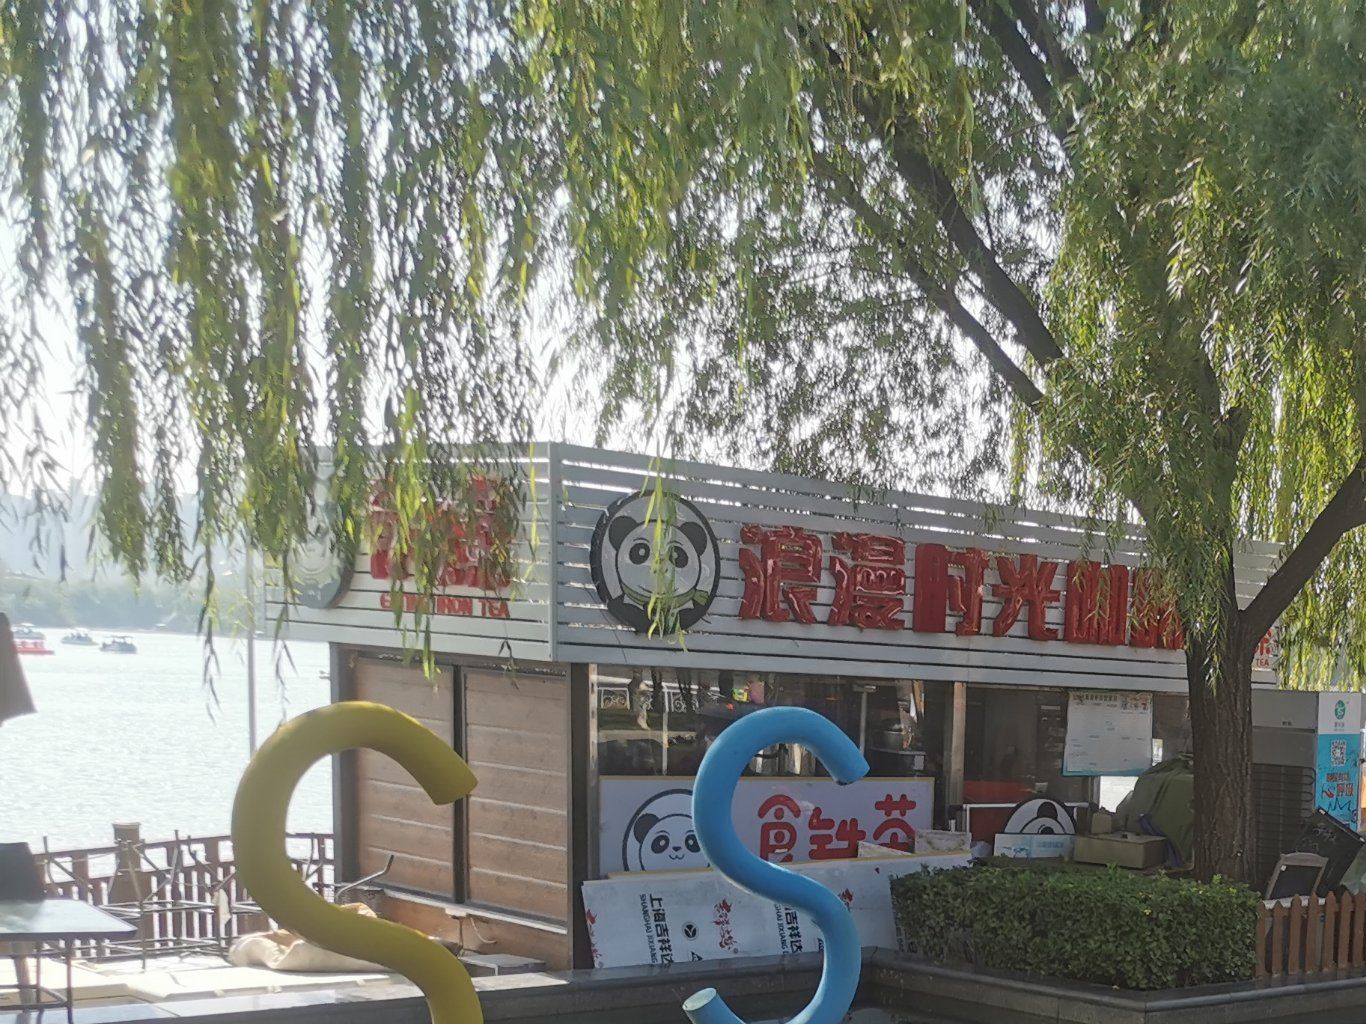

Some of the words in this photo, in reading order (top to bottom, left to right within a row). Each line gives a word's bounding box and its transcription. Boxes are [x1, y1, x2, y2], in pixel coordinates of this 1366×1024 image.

[1255, 658, 1269, 667] TEA
[785, 907, 803, 953] 吉祥达
